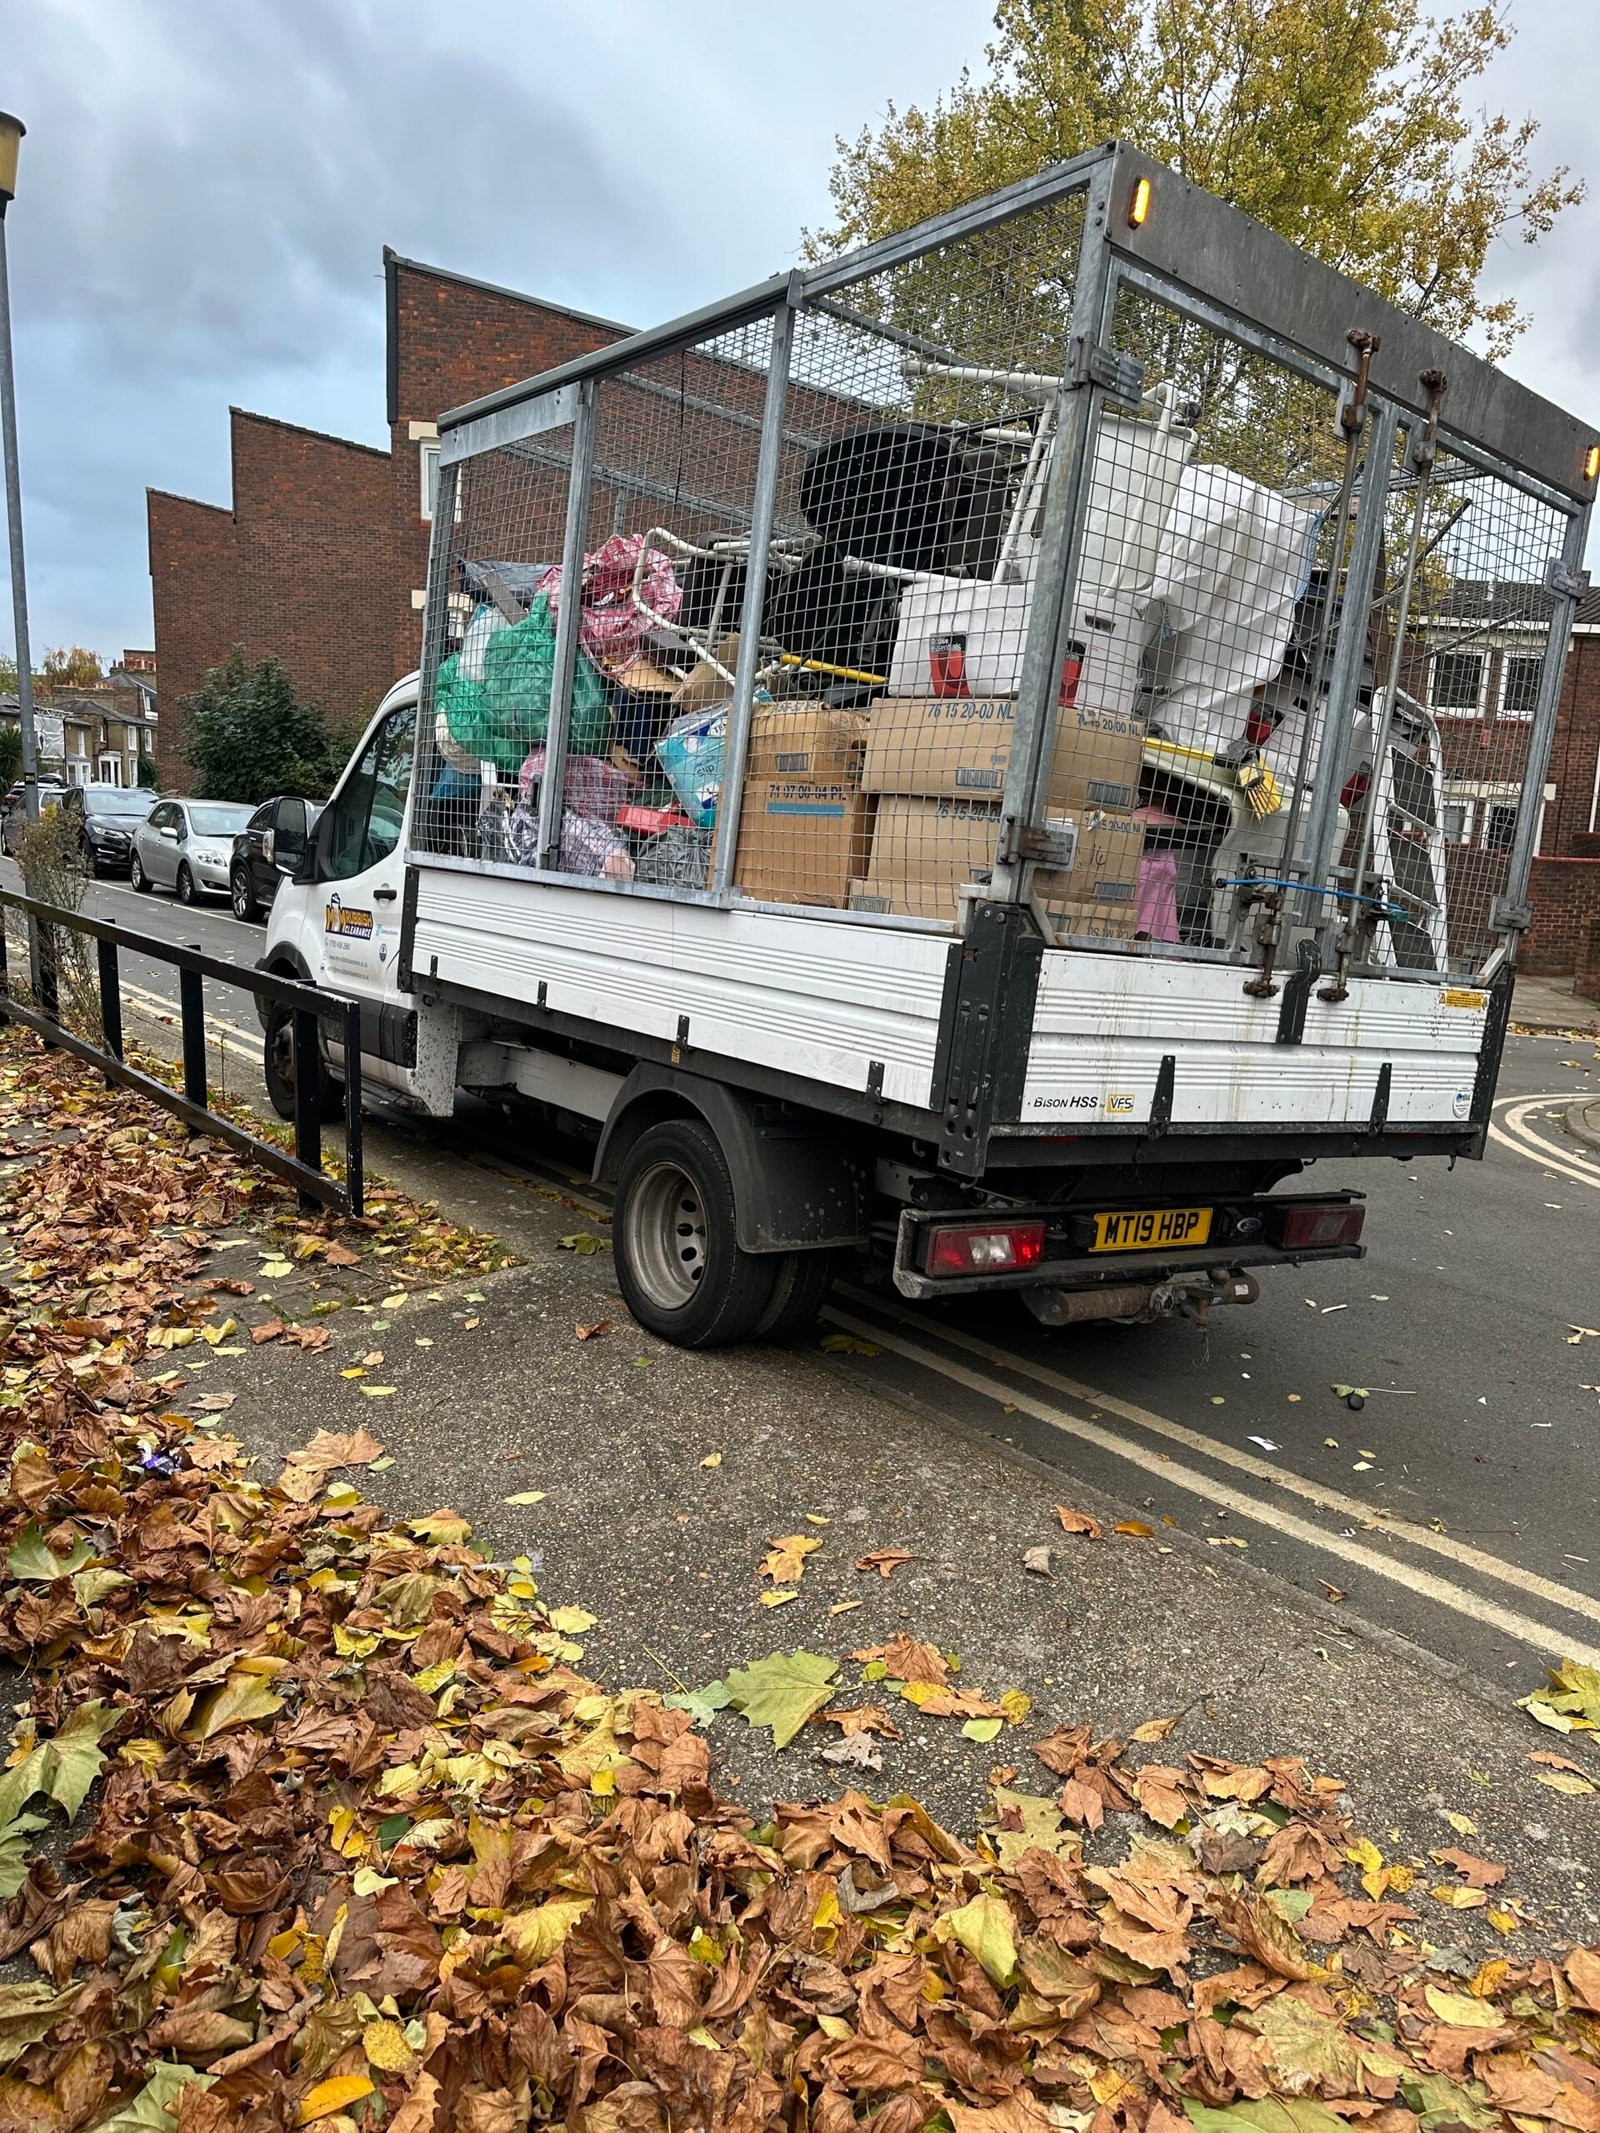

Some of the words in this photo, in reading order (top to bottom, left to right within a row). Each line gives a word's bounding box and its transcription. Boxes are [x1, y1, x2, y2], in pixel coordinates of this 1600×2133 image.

[928, 703, 941, 718] 76
[945, 703, 958, 718] 15
[960, 703, 994, 719] 20-00
[997, 703, 1015, 719] NL
[345, 910, 373, 928] RUBBISH
[344, 925, 372, 938] CLEARANCE
[1069, 1096, 1099, 1108] HSS
[1109, 1096, 1133, 1109] VFS
[1104, 1214, 1153, 1244] MT19
[1158, 1212, 1199, 1241] HBP
